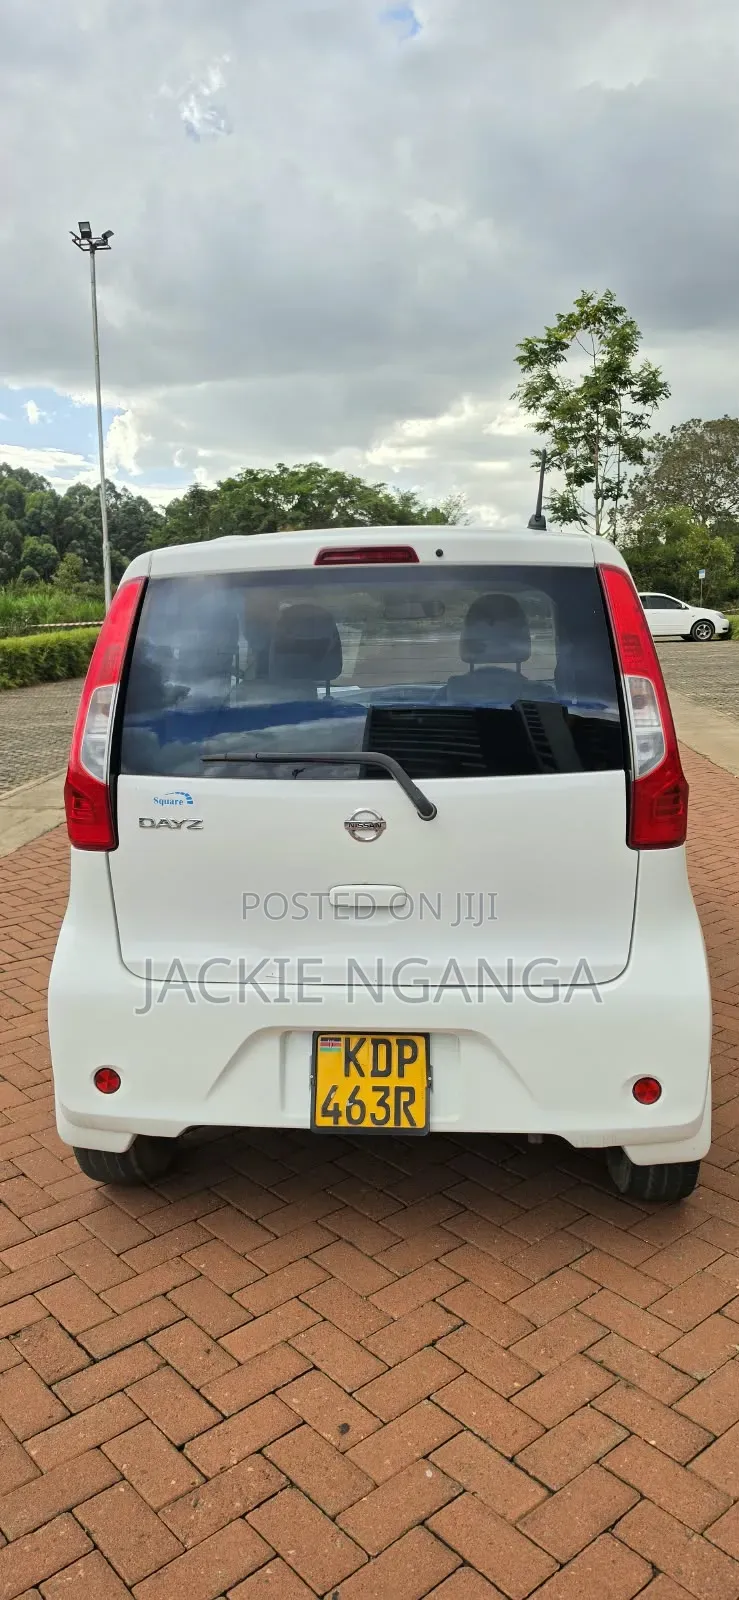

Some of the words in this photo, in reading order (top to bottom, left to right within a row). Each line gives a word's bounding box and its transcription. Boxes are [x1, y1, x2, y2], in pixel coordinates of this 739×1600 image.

[153, 796, 184, 806] Square
[138, 817, 204, 830] DAYZ
[343, 1037, 419, 1078] KDP
[320, 1084, 417, 1127] 463R
